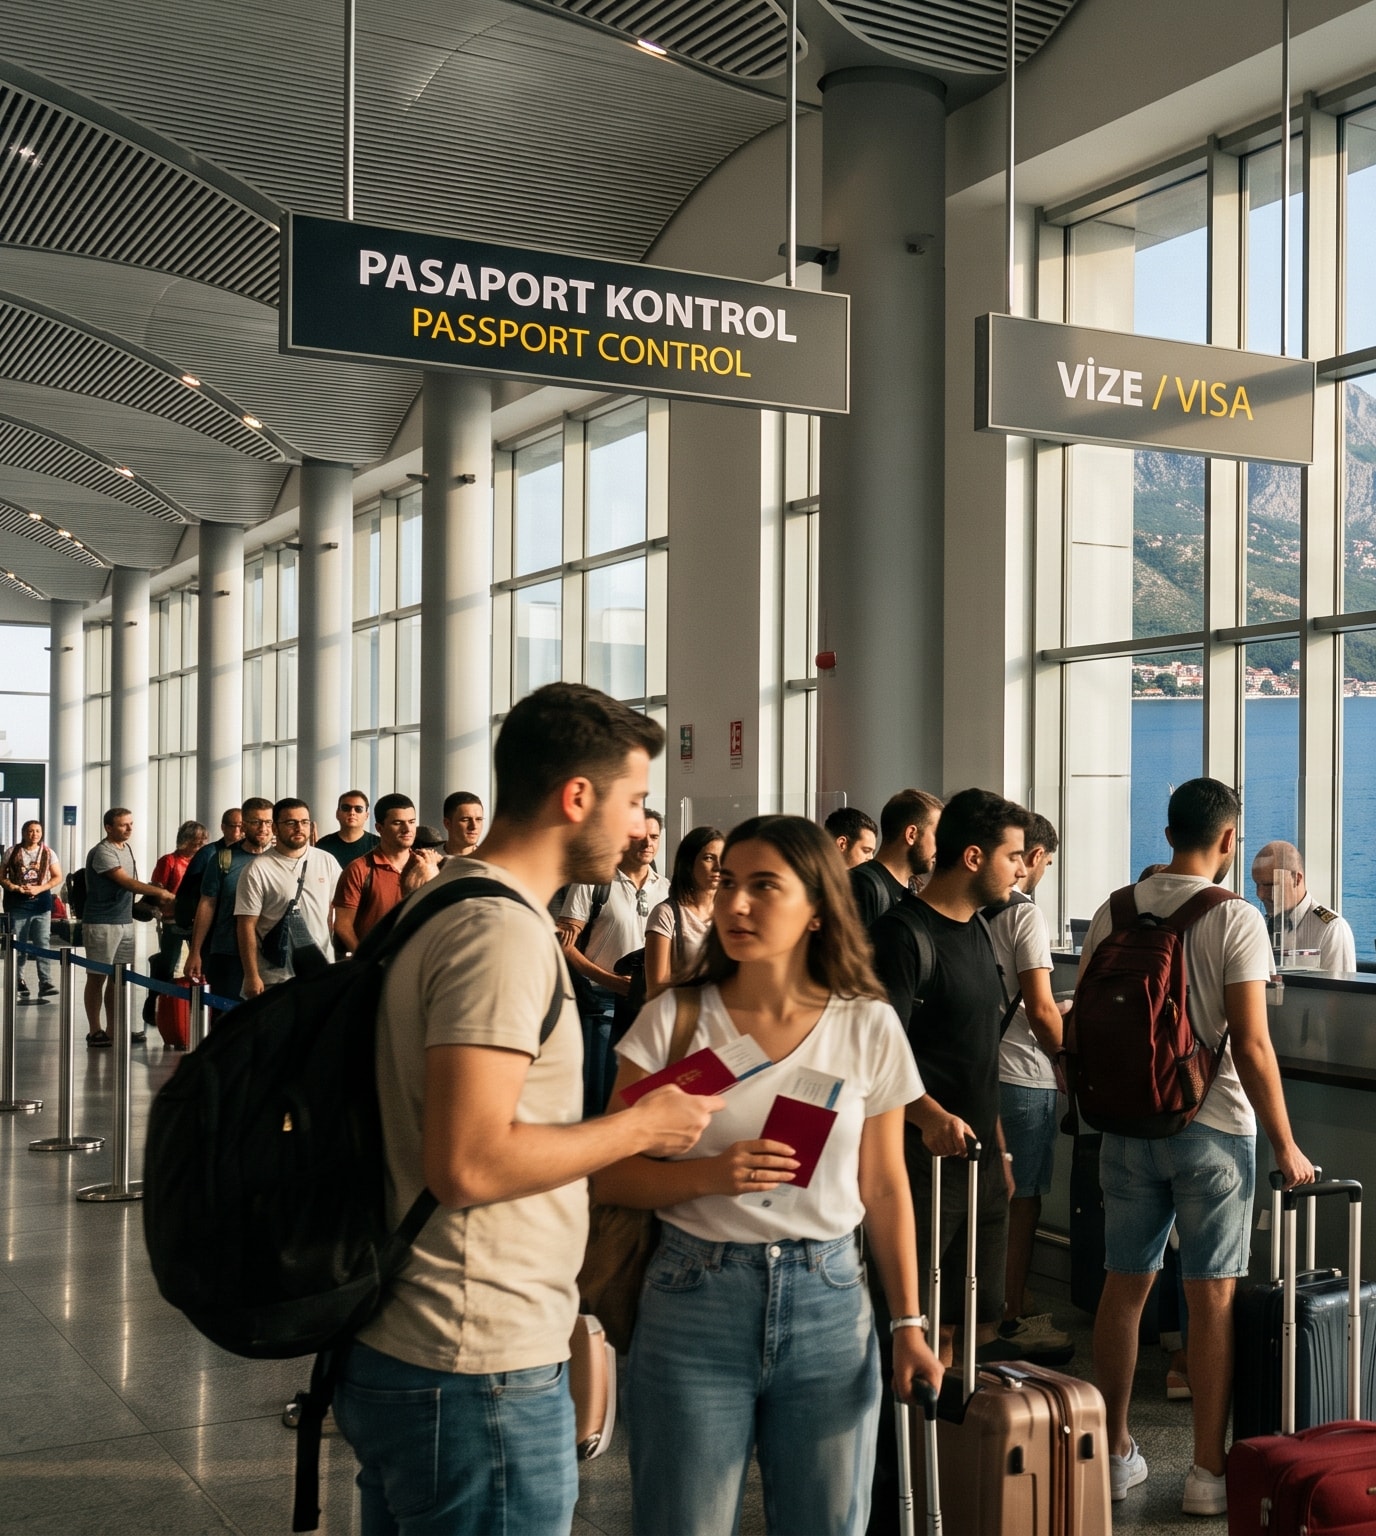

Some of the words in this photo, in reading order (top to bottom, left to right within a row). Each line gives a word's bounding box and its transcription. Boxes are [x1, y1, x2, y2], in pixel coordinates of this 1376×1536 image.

[359, 249, 595, 314] PASAPORT
[606, 284, 799, 344] KONTROL
[412, 307, 591, 358] PASSPORT
[598, 332, 752, 380] CONTROL
[1056, 356, 1144, 407] VİZE
[1175, 376, 1254, 421] VISA
